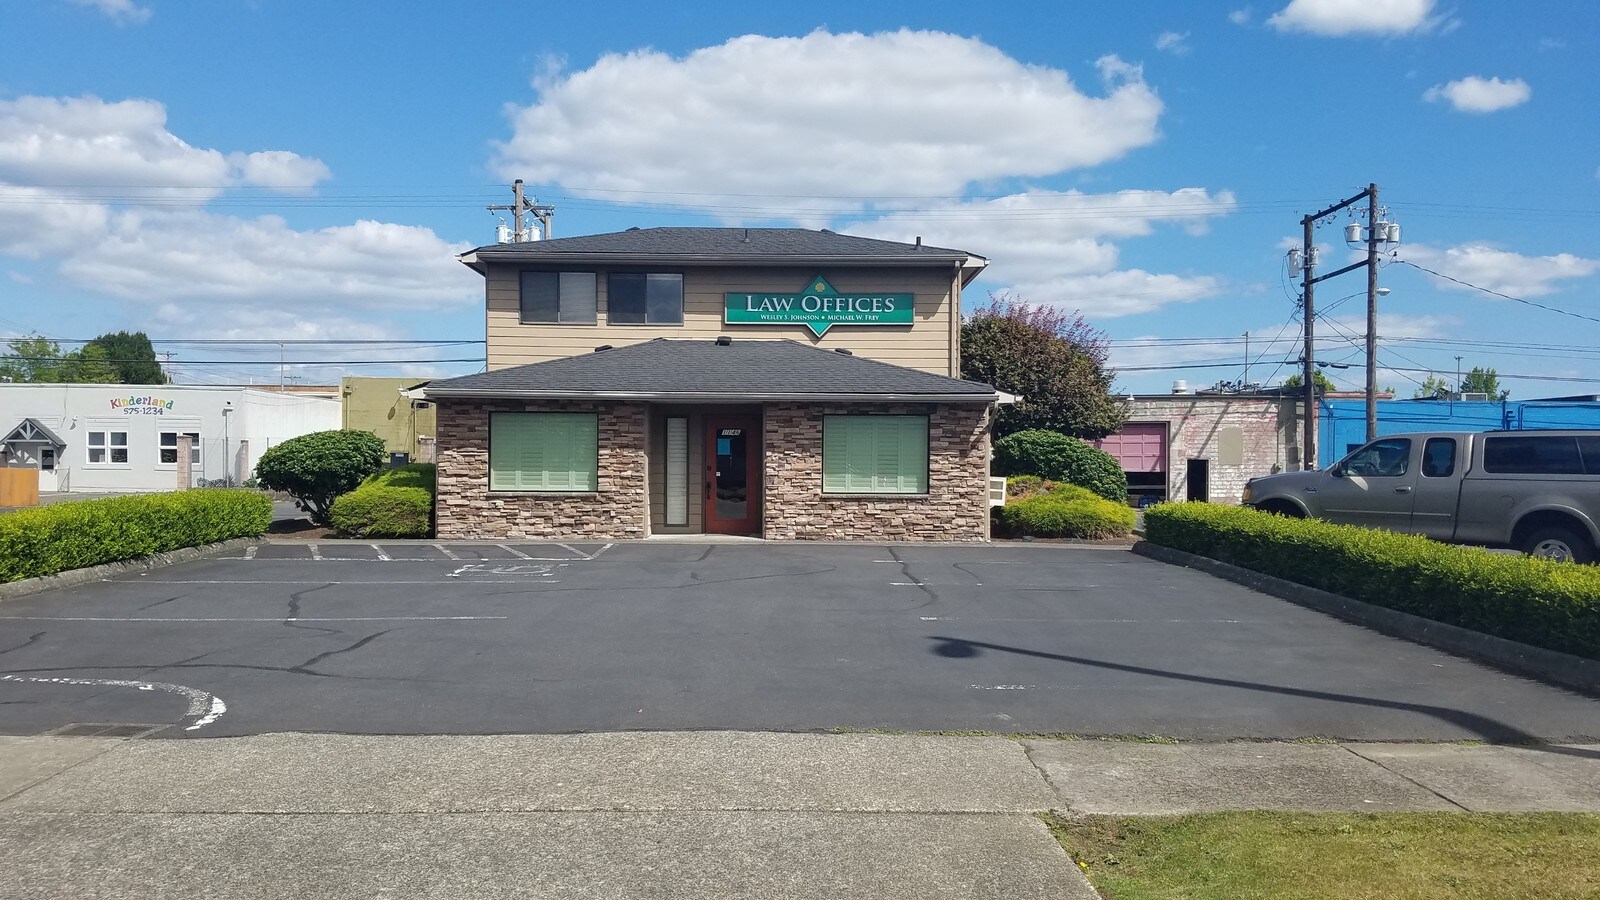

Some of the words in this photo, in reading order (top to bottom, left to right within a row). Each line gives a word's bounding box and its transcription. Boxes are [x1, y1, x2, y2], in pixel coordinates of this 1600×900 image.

[745, 295, 795, 312] LAW
[801, 295, 895, 312] OFFICES
[110, 396, 174, 410] Kinderland
[123, 407, 164, 415] 575-1234
